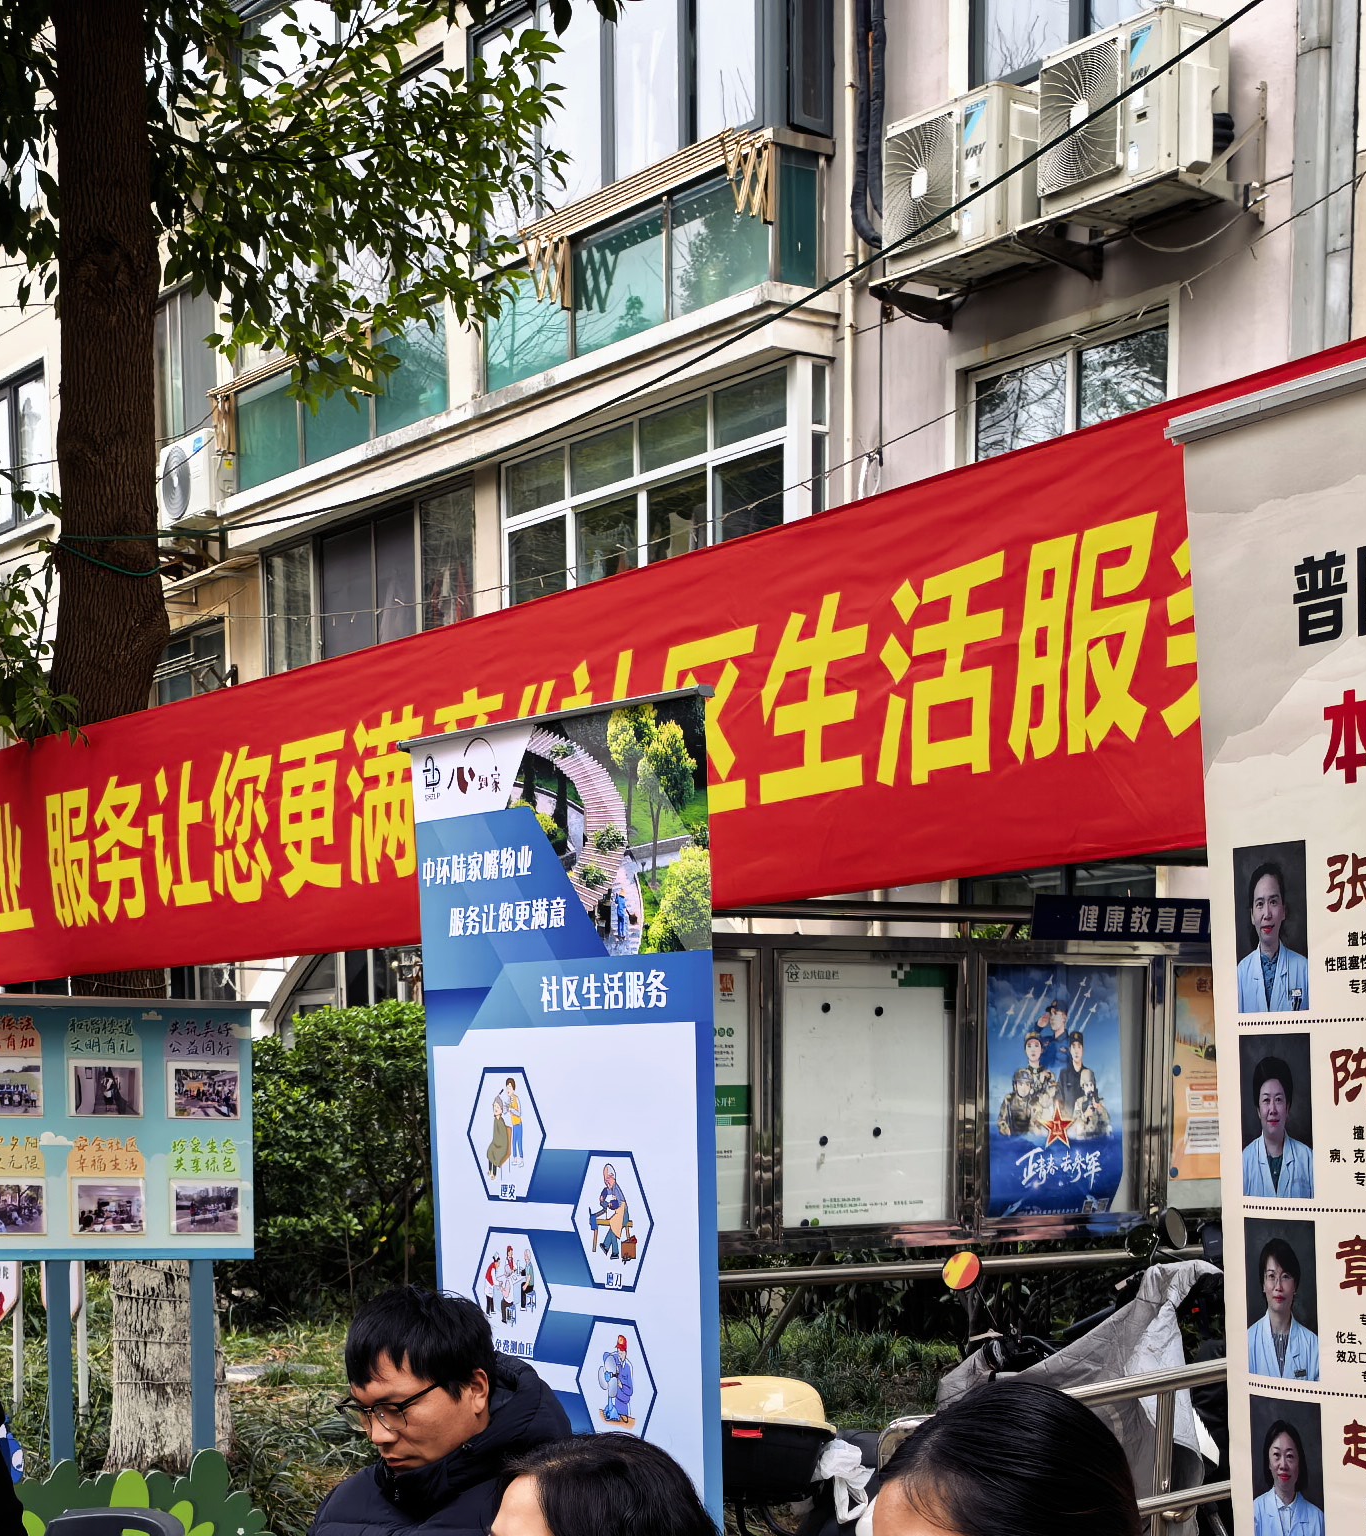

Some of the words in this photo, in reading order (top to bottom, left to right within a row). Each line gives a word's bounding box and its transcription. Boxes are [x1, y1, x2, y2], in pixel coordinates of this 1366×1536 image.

[422, 846, 533, 888] 中环陆家嘴物业
[448, 897, 566, 938] 服务让您更满意
[1079, 904, 1211, 934] 健康教育宣
[539, 969, 669, 1013] 社区生活服务
[70, 1037, 135, 1055] 文明有礼
[169, 1040, 234, 1057] 公益同行
[73, 1135, 140, 1154] 安全社区
[75, 1155, 138, 1174] 幸福生活
